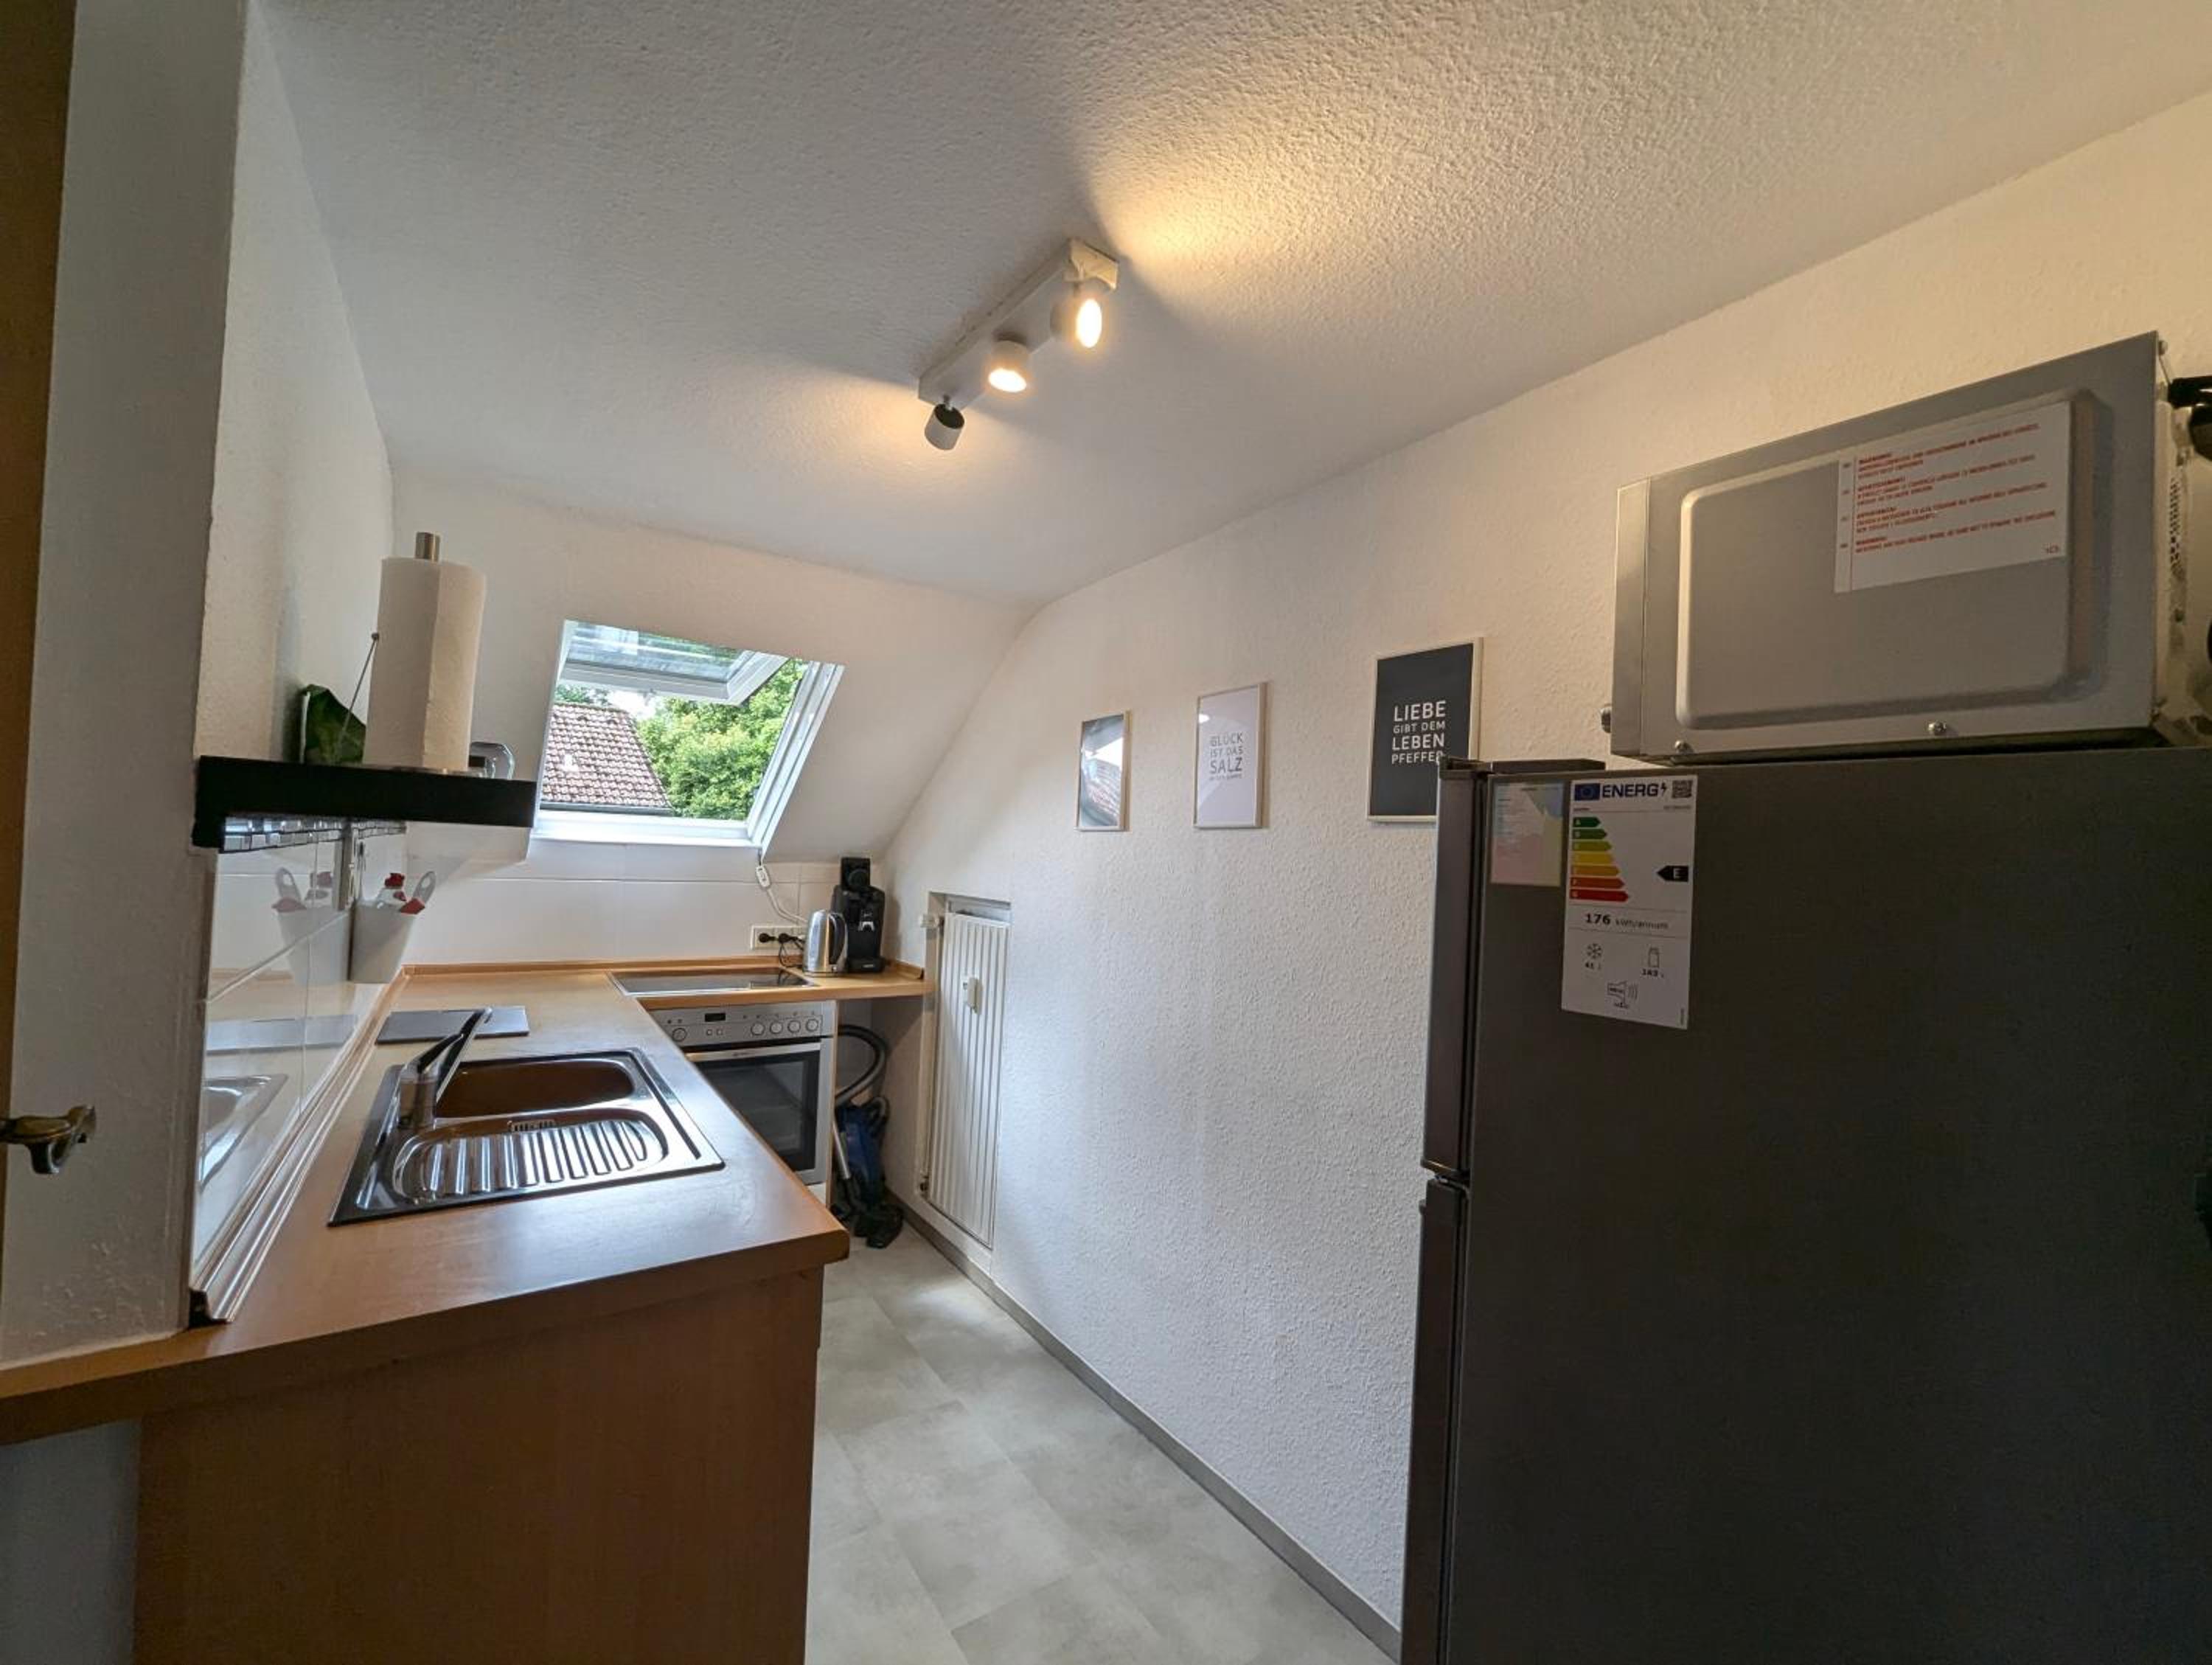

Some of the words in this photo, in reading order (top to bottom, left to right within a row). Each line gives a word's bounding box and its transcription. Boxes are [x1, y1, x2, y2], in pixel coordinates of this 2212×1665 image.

[1394, 701, 1446, 722] LIEBE
[1393, 723, 1417, 734] GIBT
[1422, 720, 1446, 731] DEM
[1392, 733, 1445, 751] LEBEN
[1210, 748, 1222, 758] IST
[1227, 745, 1243, 755] DAS
[1210, 757, 1242, 774] SALZ
[1602, 783, 1658, 798] ENERG
[1673, 869, 1680, 878] E
[1586, 913, 1611, 925] 176
